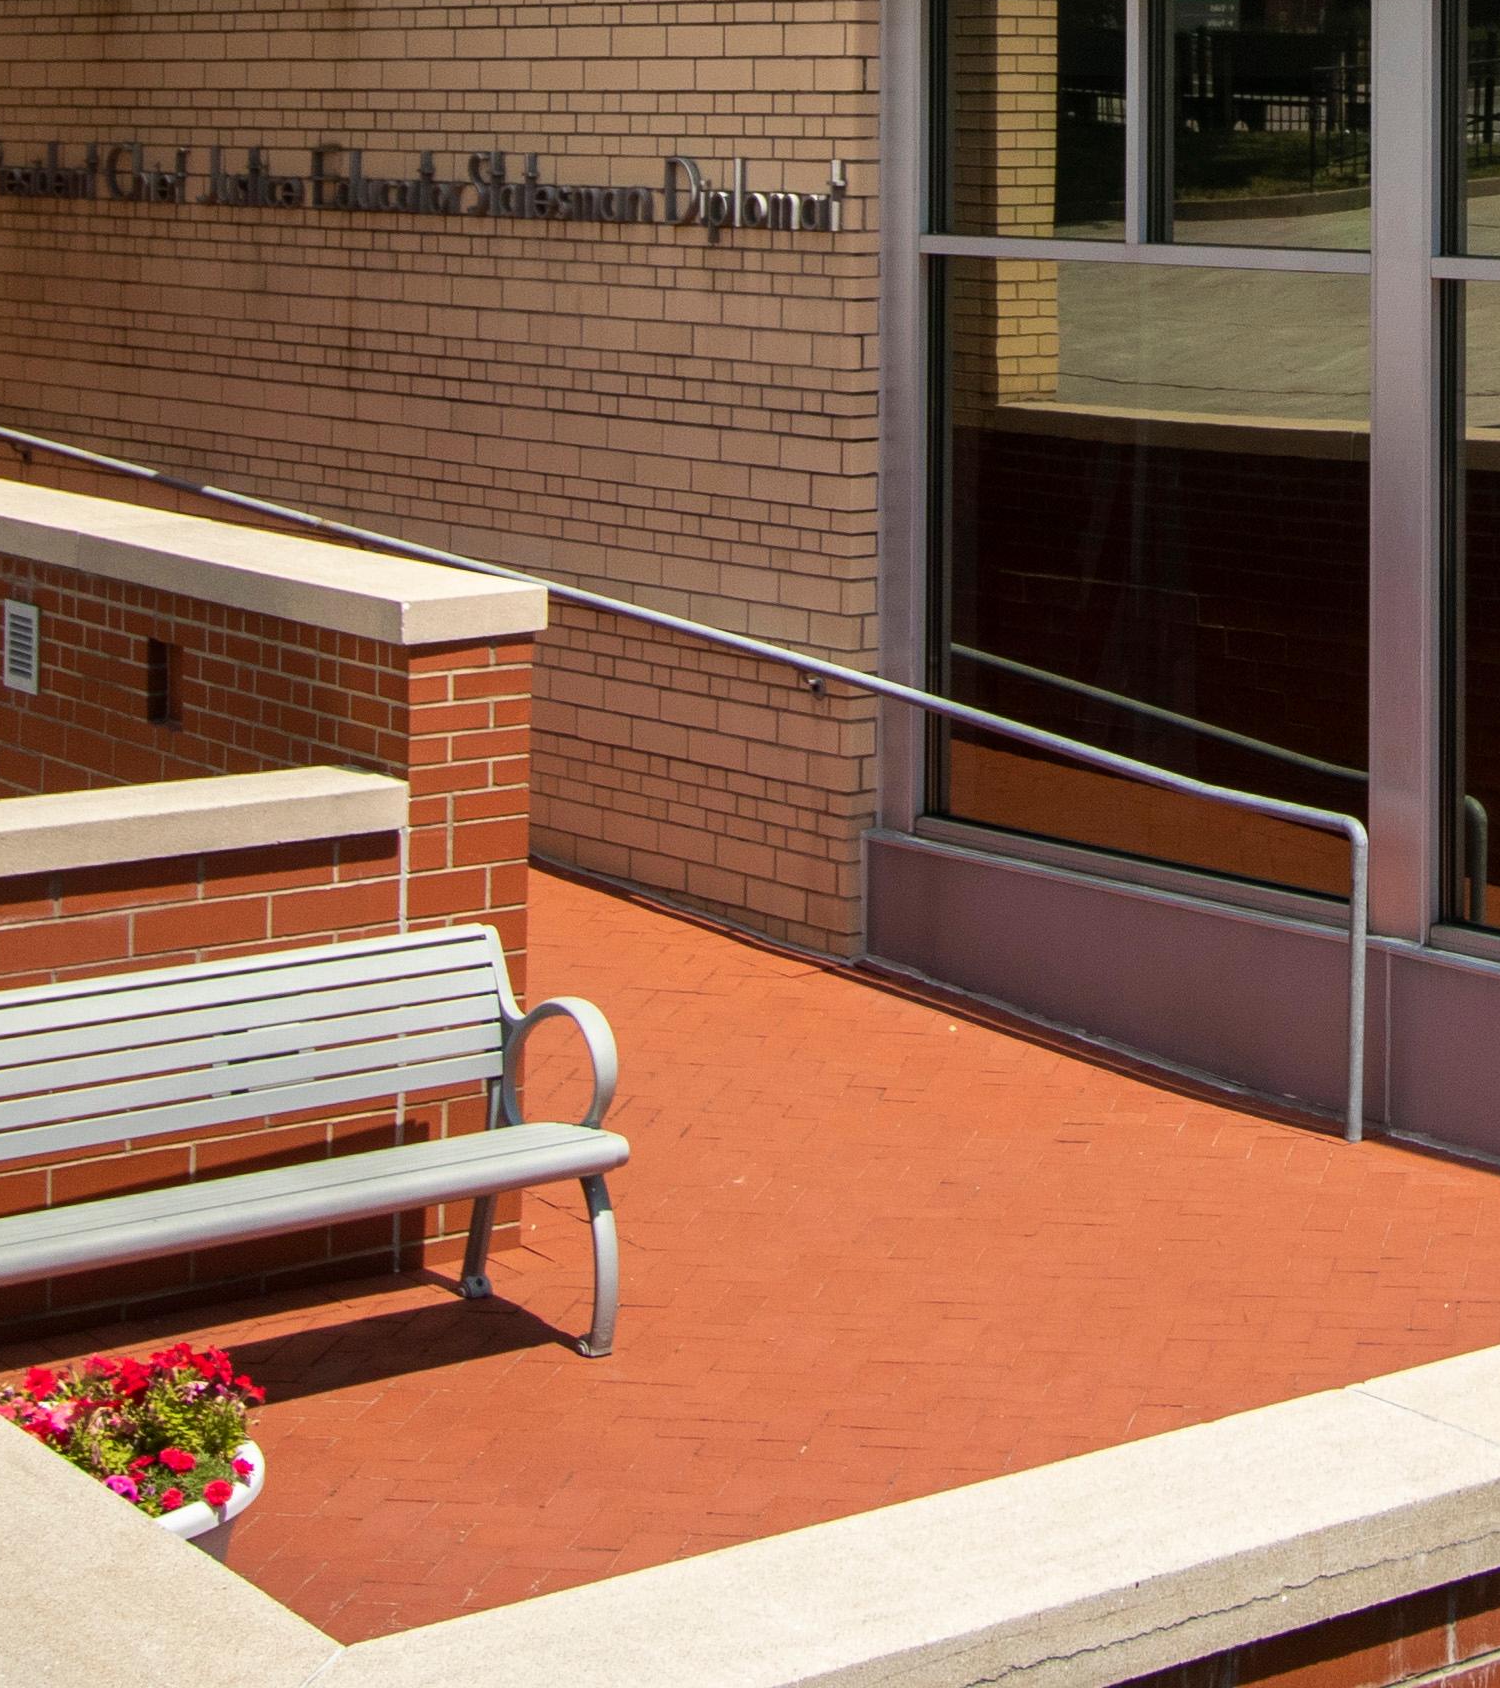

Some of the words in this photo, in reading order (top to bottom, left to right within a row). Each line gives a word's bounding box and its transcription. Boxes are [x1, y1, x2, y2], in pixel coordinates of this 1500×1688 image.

[107, 142, 189, 203] Chief
[196, 145, 306, 209] Justice
[311, 144, 464, 215] Educator
[467, 151, 654, 224] Statesman
[663, 157, 846, 244] Diplomat
